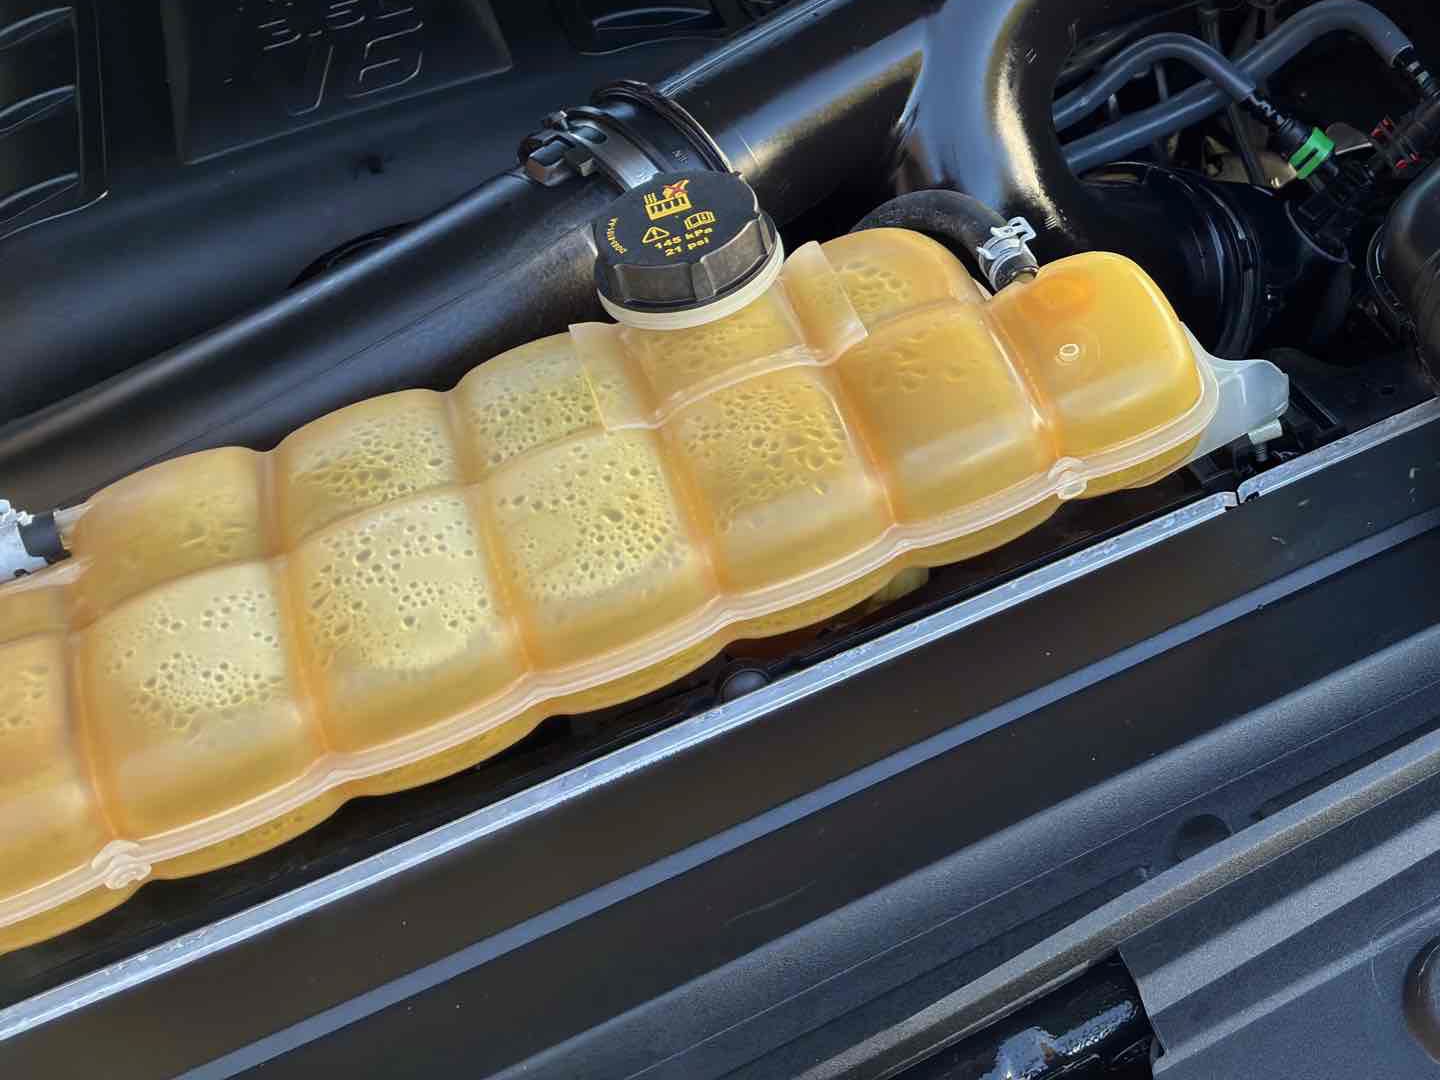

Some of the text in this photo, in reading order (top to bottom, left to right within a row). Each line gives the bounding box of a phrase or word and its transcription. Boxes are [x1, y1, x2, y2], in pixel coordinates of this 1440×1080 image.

[654, 227, 713, 249] 145 kPa
[665, 237, 709, 257] 21 psi
